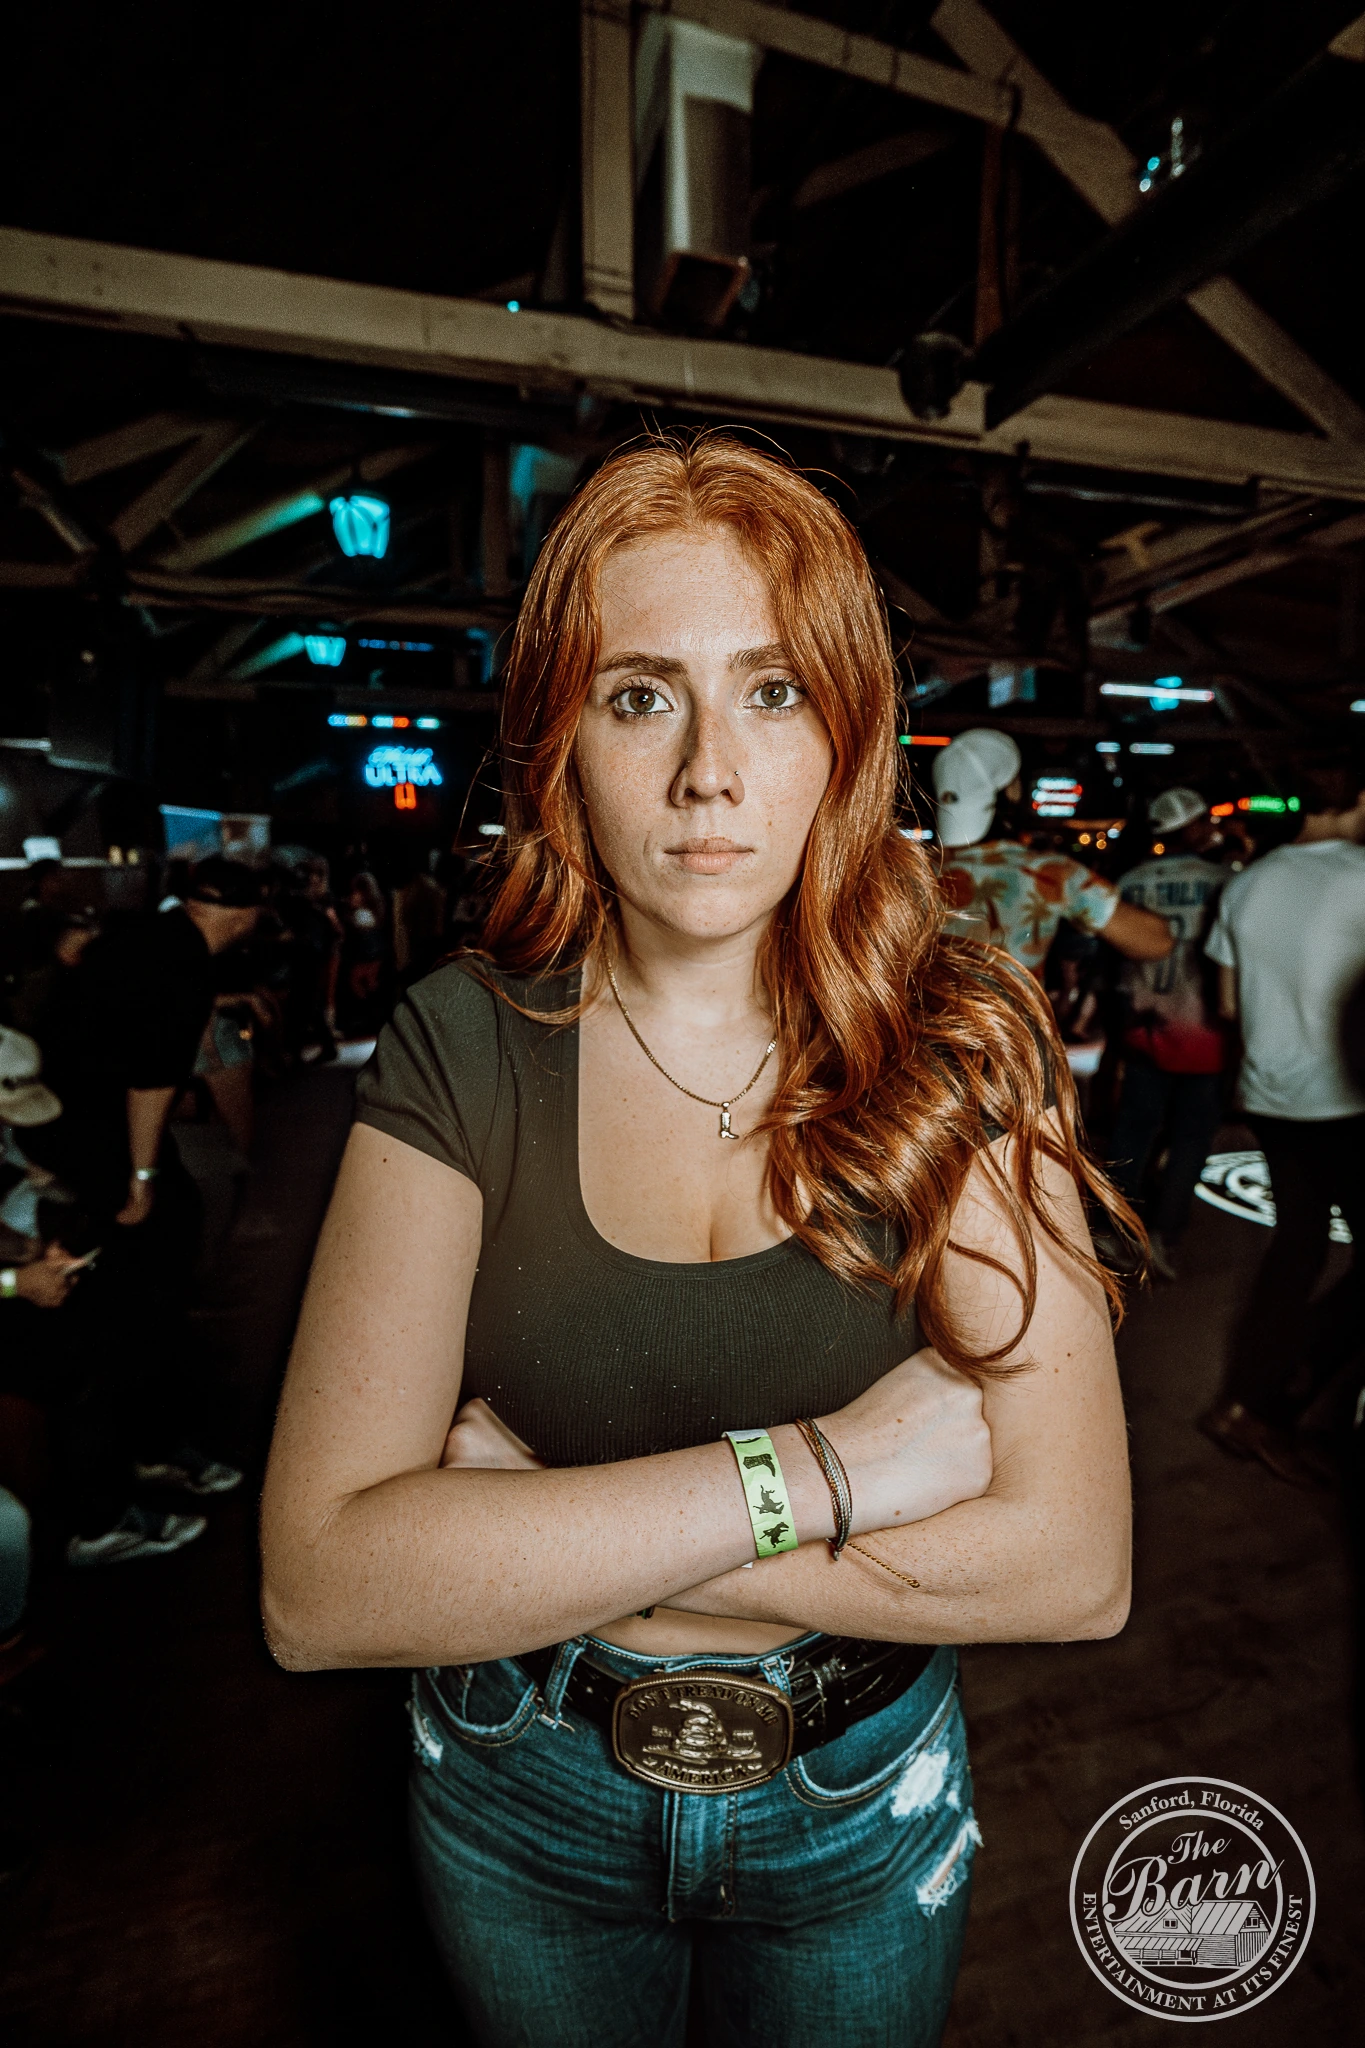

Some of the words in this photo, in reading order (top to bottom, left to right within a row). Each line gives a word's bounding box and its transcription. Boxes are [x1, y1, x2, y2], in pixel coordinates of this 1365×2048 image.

[672, 1683, 733, 1700] TREAD
[733, 1690, 760, 1709] ON
[755, 1702, 779, 1728] ME
[657, 1760, 749, 1785] AMERICA
